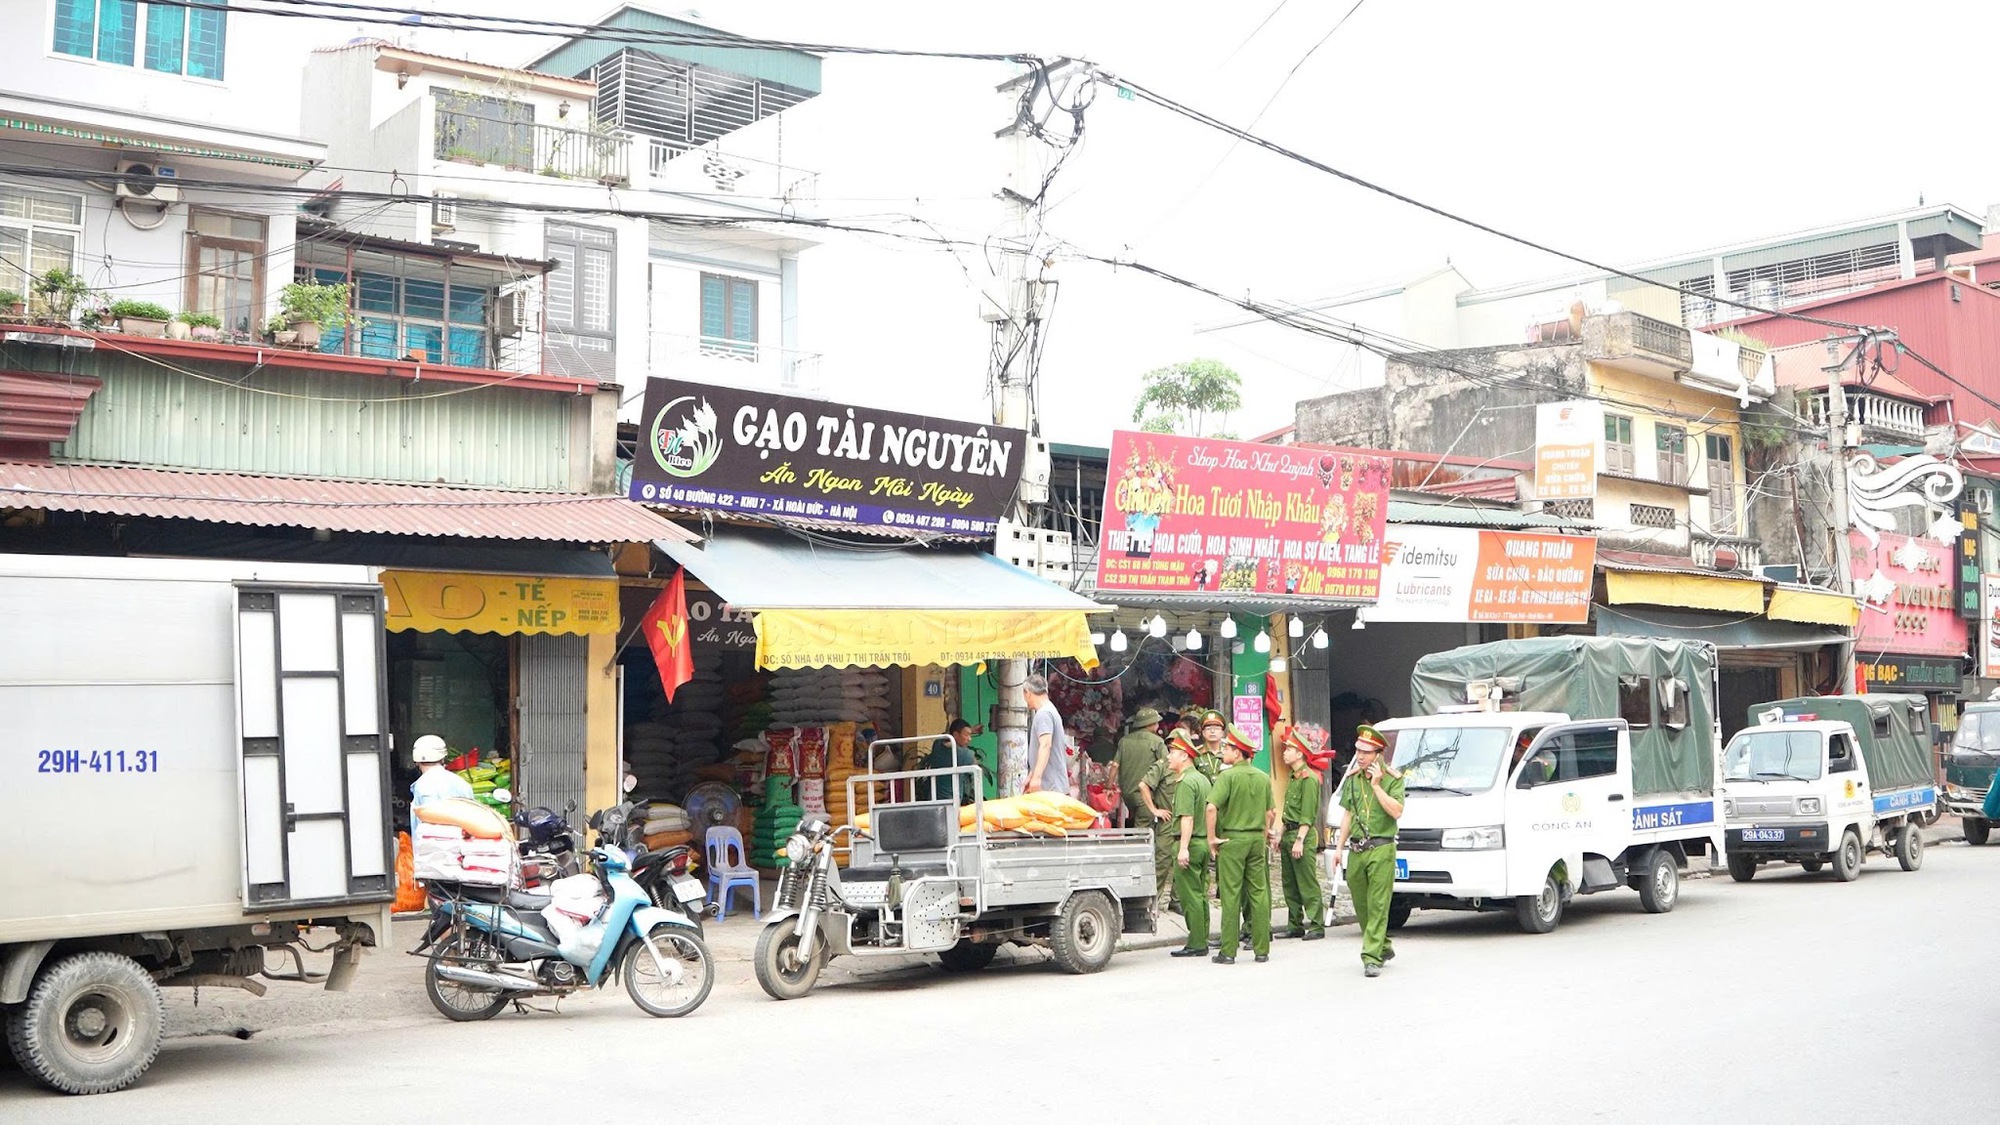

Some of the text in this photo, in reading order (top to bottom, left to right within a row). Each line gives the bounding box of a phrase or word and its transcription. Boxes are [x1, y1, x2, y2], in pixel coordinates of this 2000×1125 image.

[732, 404, 1013, 478] GẠO TÀI NGUYÊN
[1188, 446, 1315, 480] Shop Hoa Như Quỳnh
[760, 461, 975, 507] Ăn Ngon Mỗi Ngày
[659, 485, 672, 499] SỐ
[674, 489, 684, 500] 40
[686, 489, 716, 504] ĐƯỜNG
[717, 493, 733, 506] 422
[740, 496, 758, 510] KHU
[760, 498, 766, 510] 7
[772, 497, 784, 512] XÃ
[786, 499, 805, 514] HOÀI
[830, 504, 842, 517] HÀ
[843, 505, 858, 520] NỘI
[1174, 484, 1206, 516] Hoa
[1211, 486, 1243, 518] Tươi
[1245, 489, 1282, 529] Nhập
[1285, 488, 1320, 524] Khẩu
[1155, 536, 1176, 554] HOA
[1206, 538, 1226, 556] HOA
[1229, 540, 1252, 558] SINH
[1253, 538, 1281, 560] NHẬT,
[1283, 542, 1302, 560] HOA
[1304, 541, 1318, 563] SỰ
[1345, 544, 1367, 562] TANG
[1402, 546, 1458, 566] idemitsu
[1506, 539, 1574, 563] QUANG THUẬN
[1300, 566, 1325, 594] Zalo:
[1348, 568, 1362, 580] 179
[1486, 562, 1504, 580] SỬA
[1506, 564, 1530, 582] CHỮA
[1538, 564, 1554, 582] BẢO
[516, 577, 546, 601] TẺ
[1396, 582, 1452, 596] Lubricants
[1498, 590, 1507, 604] XE
[518, 601, 566, 627] NẾP
[1894, 612, 1927, 634] 9999
[697, 627, 720, 643] Ăn
[764, 654, 778, 664] ĐC:
[814, 654, 824, 664] 40
[827, 653, 844, 663] KHU
[846, 653, 850, 663] 7
[854, 652, 867, 664] THỊ
[870, 650, 890, 662] TRẤN
[955, 652, 974, 660] 0934
[1878, 664, 1898, 684] BẠC
[928, 684, 938, 695] 40
[1248, 684, 1257, 694] 38
[38, 750, 158, 772] 29H-411.31
[1575, 820, 1592, 828] AN
[1660, 807, 1682, 826] SÁT
